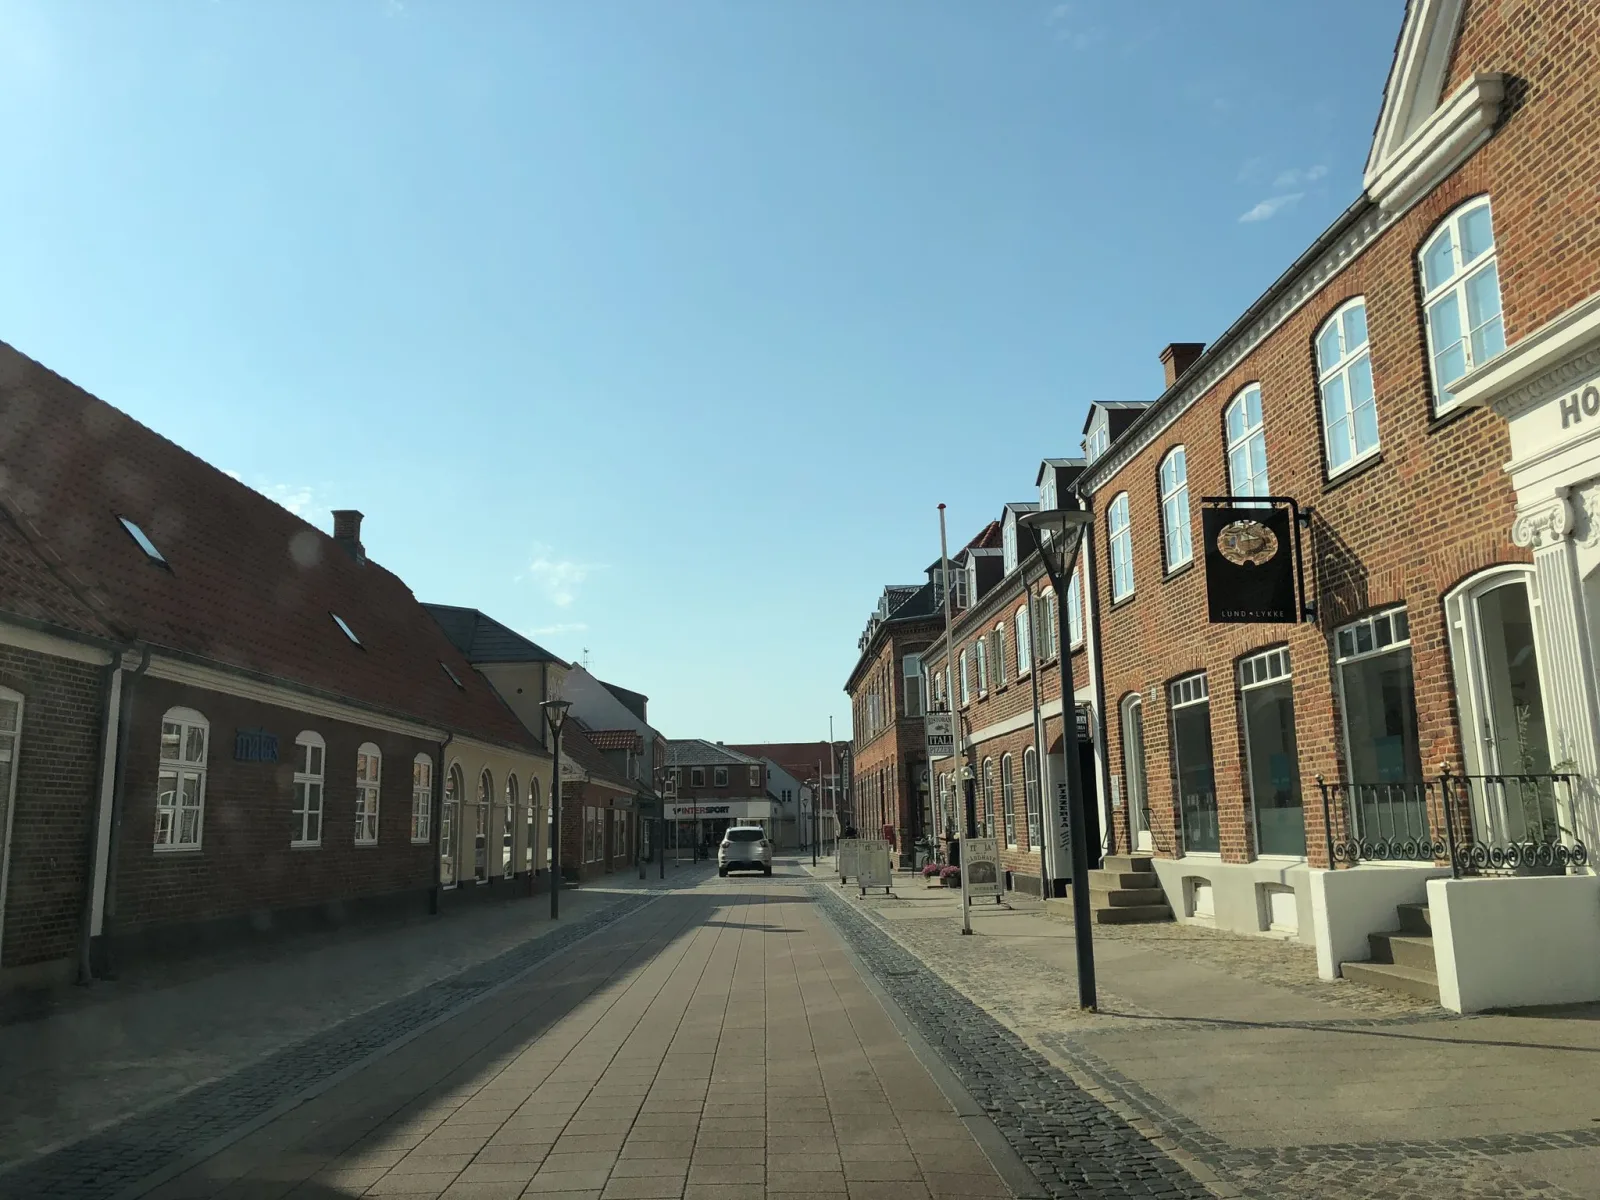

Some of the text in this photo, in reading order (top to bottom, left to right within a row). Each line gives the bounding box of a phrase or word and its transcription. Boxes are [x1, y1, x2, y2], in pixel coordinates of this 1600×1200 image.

[1221, 610, 1284, 618] LUND LYKKE
[929, 735, 953, 745] ITALI
[929, 746, 953, 754] PIZZER
[1057, 783, 1069, 828] PIZZERIA
[682, 806, 730, 814] INTERSPORT
